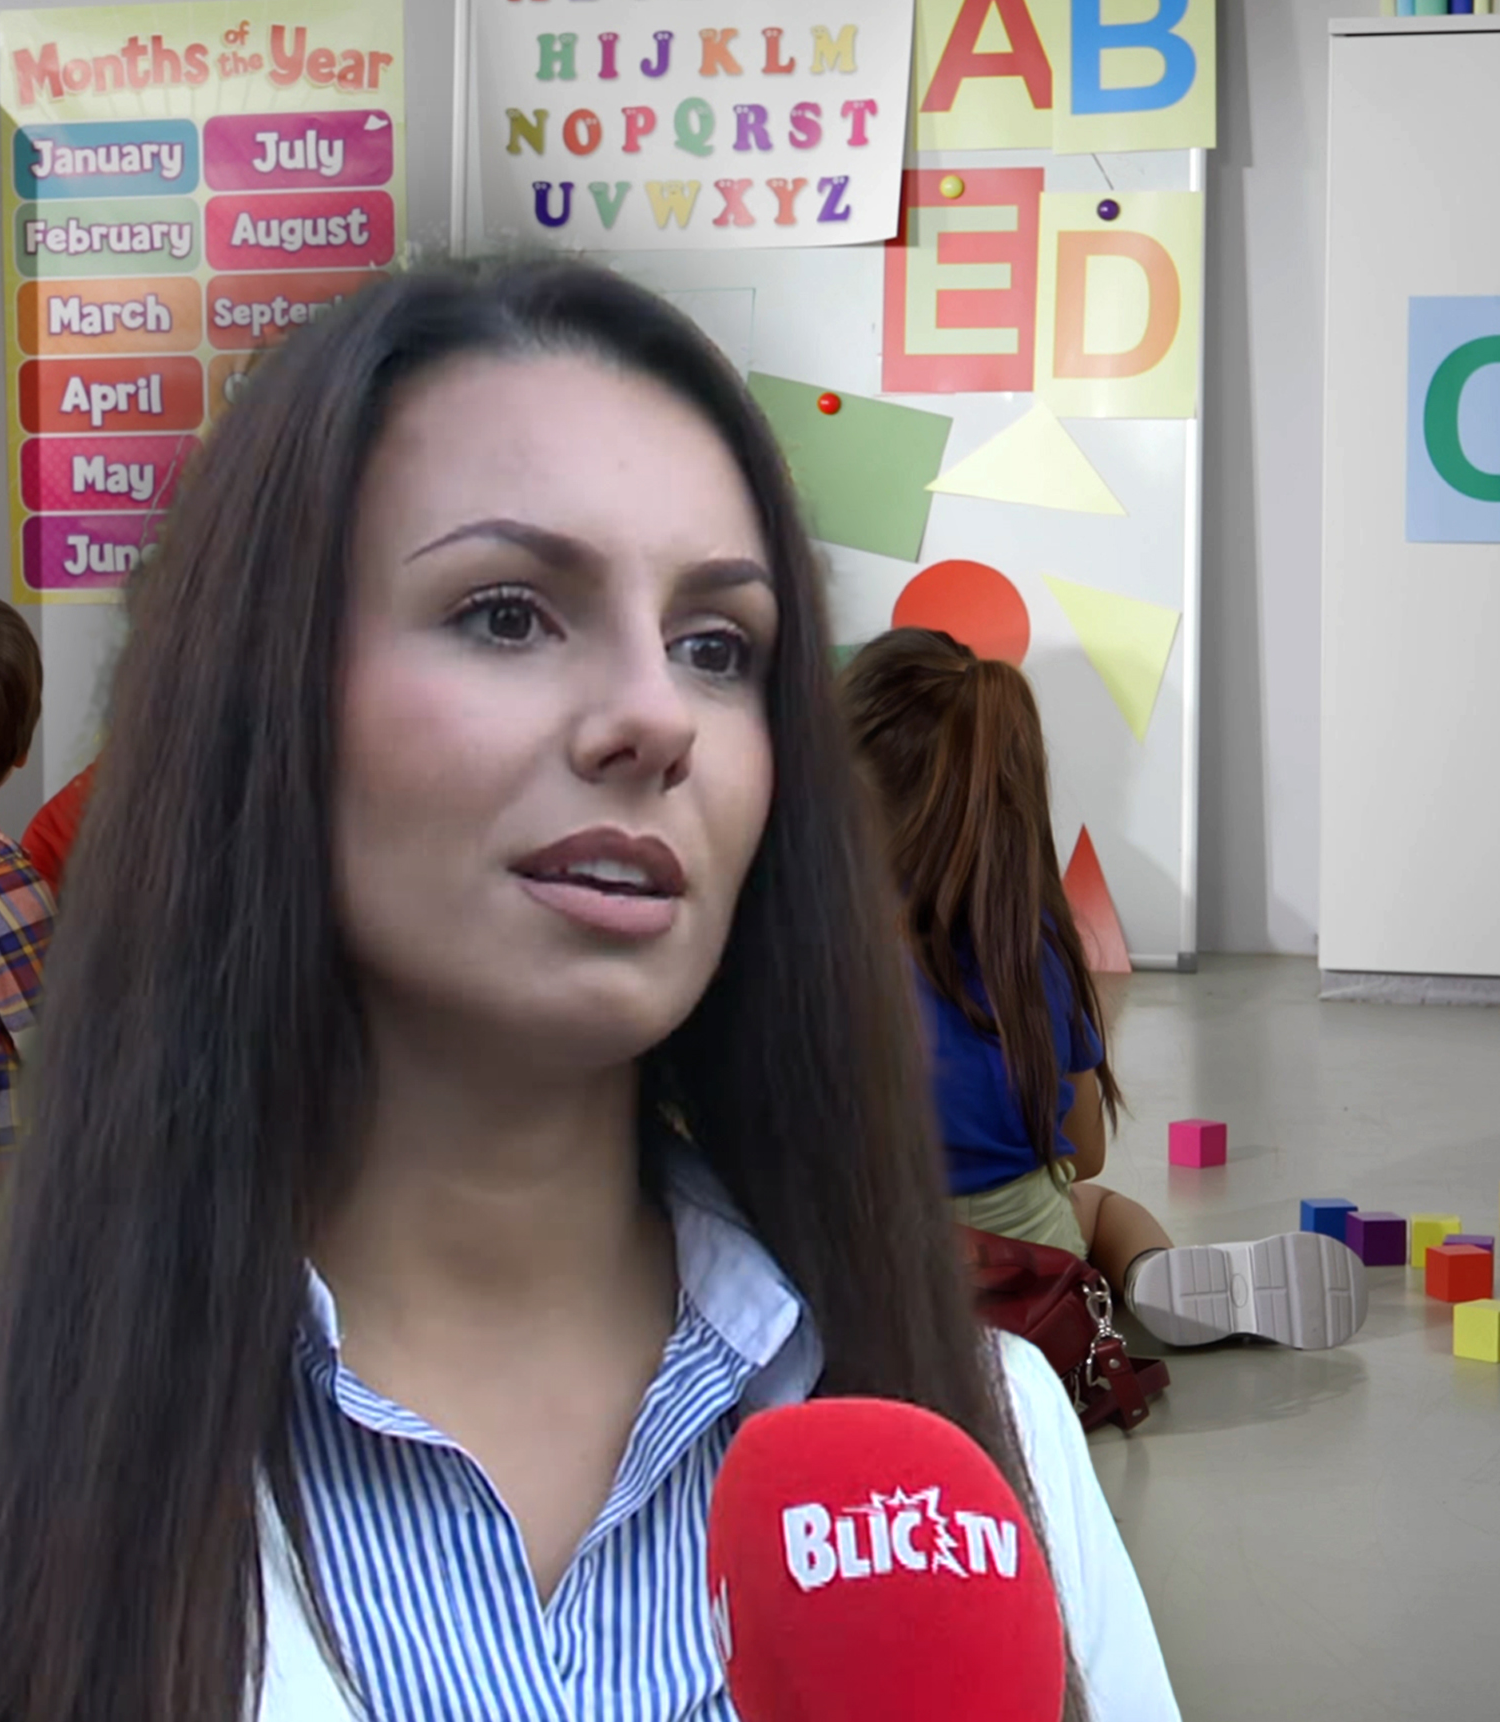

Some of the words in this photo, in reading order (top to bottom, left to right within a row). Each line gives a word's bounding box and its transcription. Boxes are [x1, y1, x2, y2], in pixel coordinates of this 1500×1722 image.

[224, 20, 250, 46] of
[12, 35, 209, 106] Months
[217, 51, 264, 78] the
[268, 24, 393, 91] Year
[919, 0, 1052, 112] A
[1070, 0, 1197, 115] B
[30, 138, 184, 178] January
[252, 130, 344, 176] July
[25, 218, 192, 258] February
[230, 208, 369, 251] August
[48, 294, 172, 336] March
[213, 295, 343, 337] Septem
[1052, 230, 1181, 379] D
[61, 374, 163, 427] April
[72, 455, 155, 501] May
[782, 1502, 928, 1592] BLIC
[954, 1510, 1018, 1579] TV
